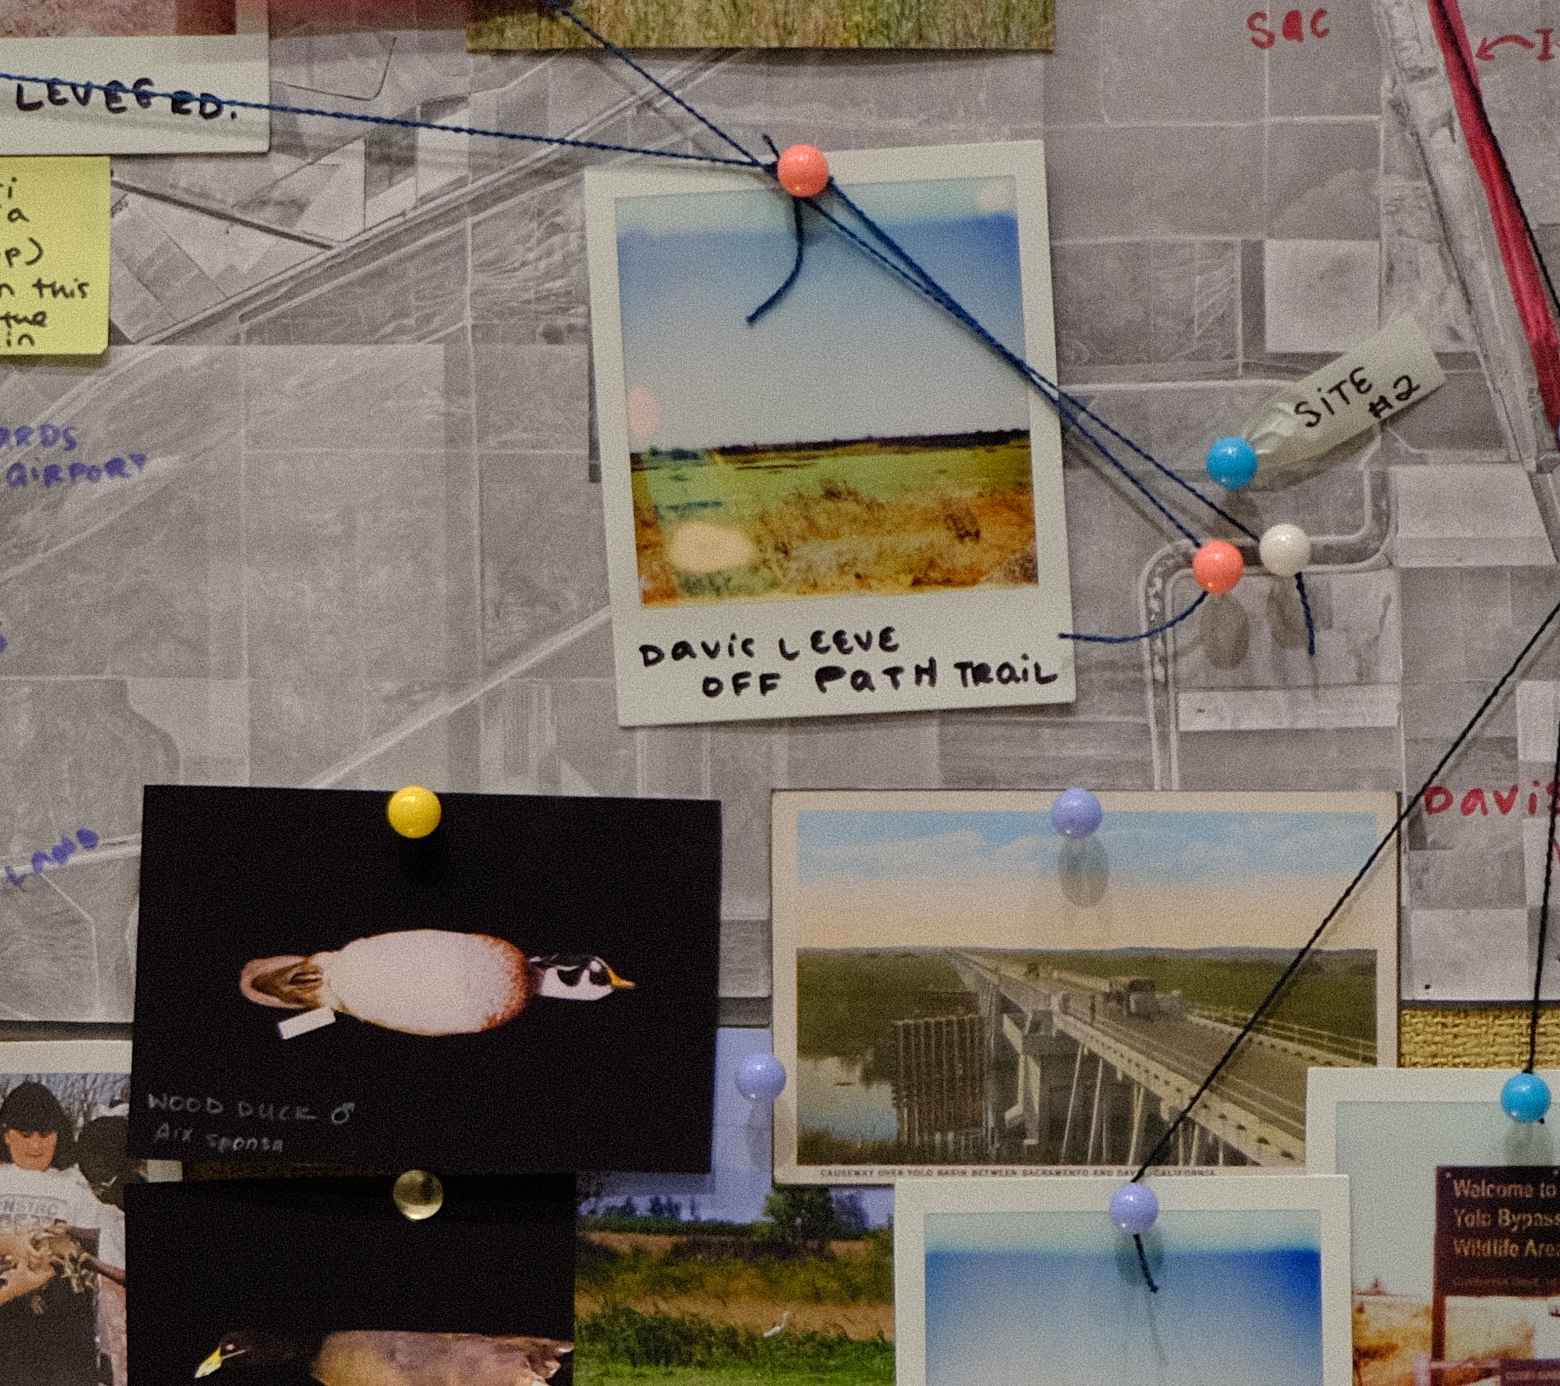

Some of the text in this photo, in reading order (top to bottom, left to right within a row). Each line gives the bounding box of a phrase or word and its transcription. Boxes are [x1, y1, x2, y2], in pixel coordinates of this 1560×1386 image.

[34, 276, 90, 299] this
[703, 670, 781, 700] OFF
[1453, 1180, 1534, 1199] Welcome
[1540, 1180, 1557, 1198] to
[1453, 1210, 1491, 1229] Yolo
[1453, 1239, 1519, 1258] Wildlife
